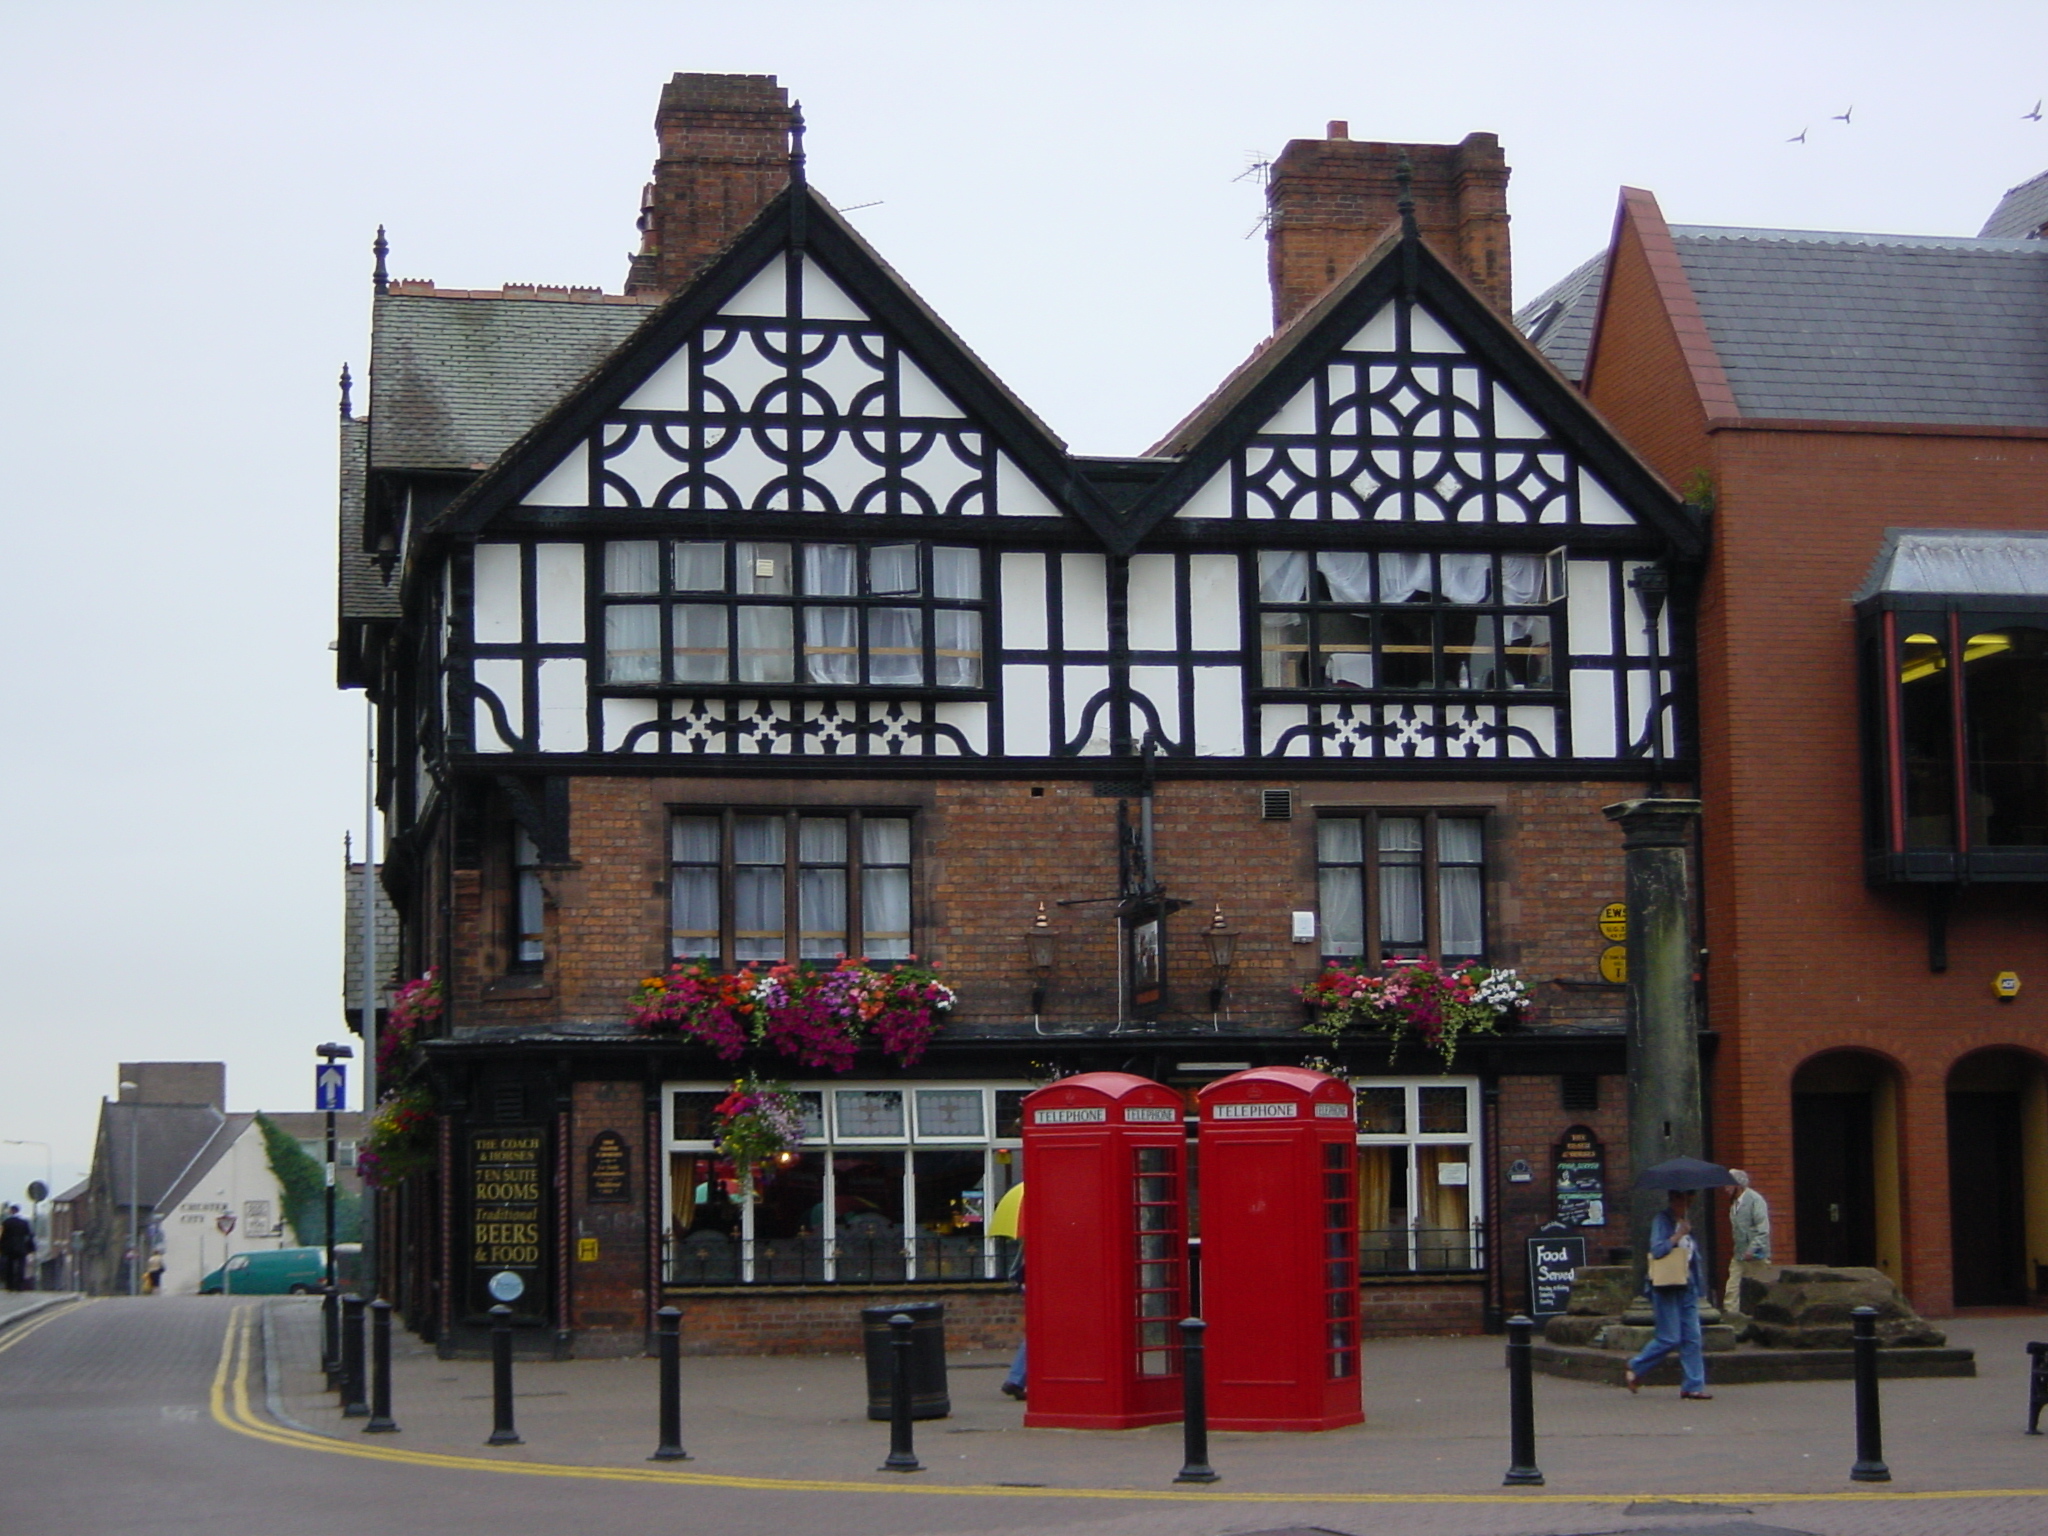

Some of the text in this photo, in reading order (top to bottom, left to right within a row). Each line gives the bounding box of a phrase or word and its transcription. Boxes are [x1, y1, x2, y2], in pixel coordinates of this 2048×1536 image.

[1039, 1109, 1103, 1123] TELEPHONE
[1126, 1108, 1174, 1121] TELEPHONE
[1217, 1104, 1294, 1118] TELEPHONE
[475, 1138, 540, 1150] THE COACH
[479, 1150, 535, 1161] & HORSES
[475, 1169, 539, 1181] 7 EN SUITE
[476, 1182, 539, 1200] ROOMS
[181, 1203, 228, 1211] CHESTER
[475, 1207, 538, 1221] Traditional
[181, 1214, 204, 1222] CITY
[475, 1223, 539, 1244] BEERS
[475, 1245, 539, 1262] & FOOD
[1536, 1244, 1568, 1266] Food
[1537, 1265, 1575, 1282] Served
